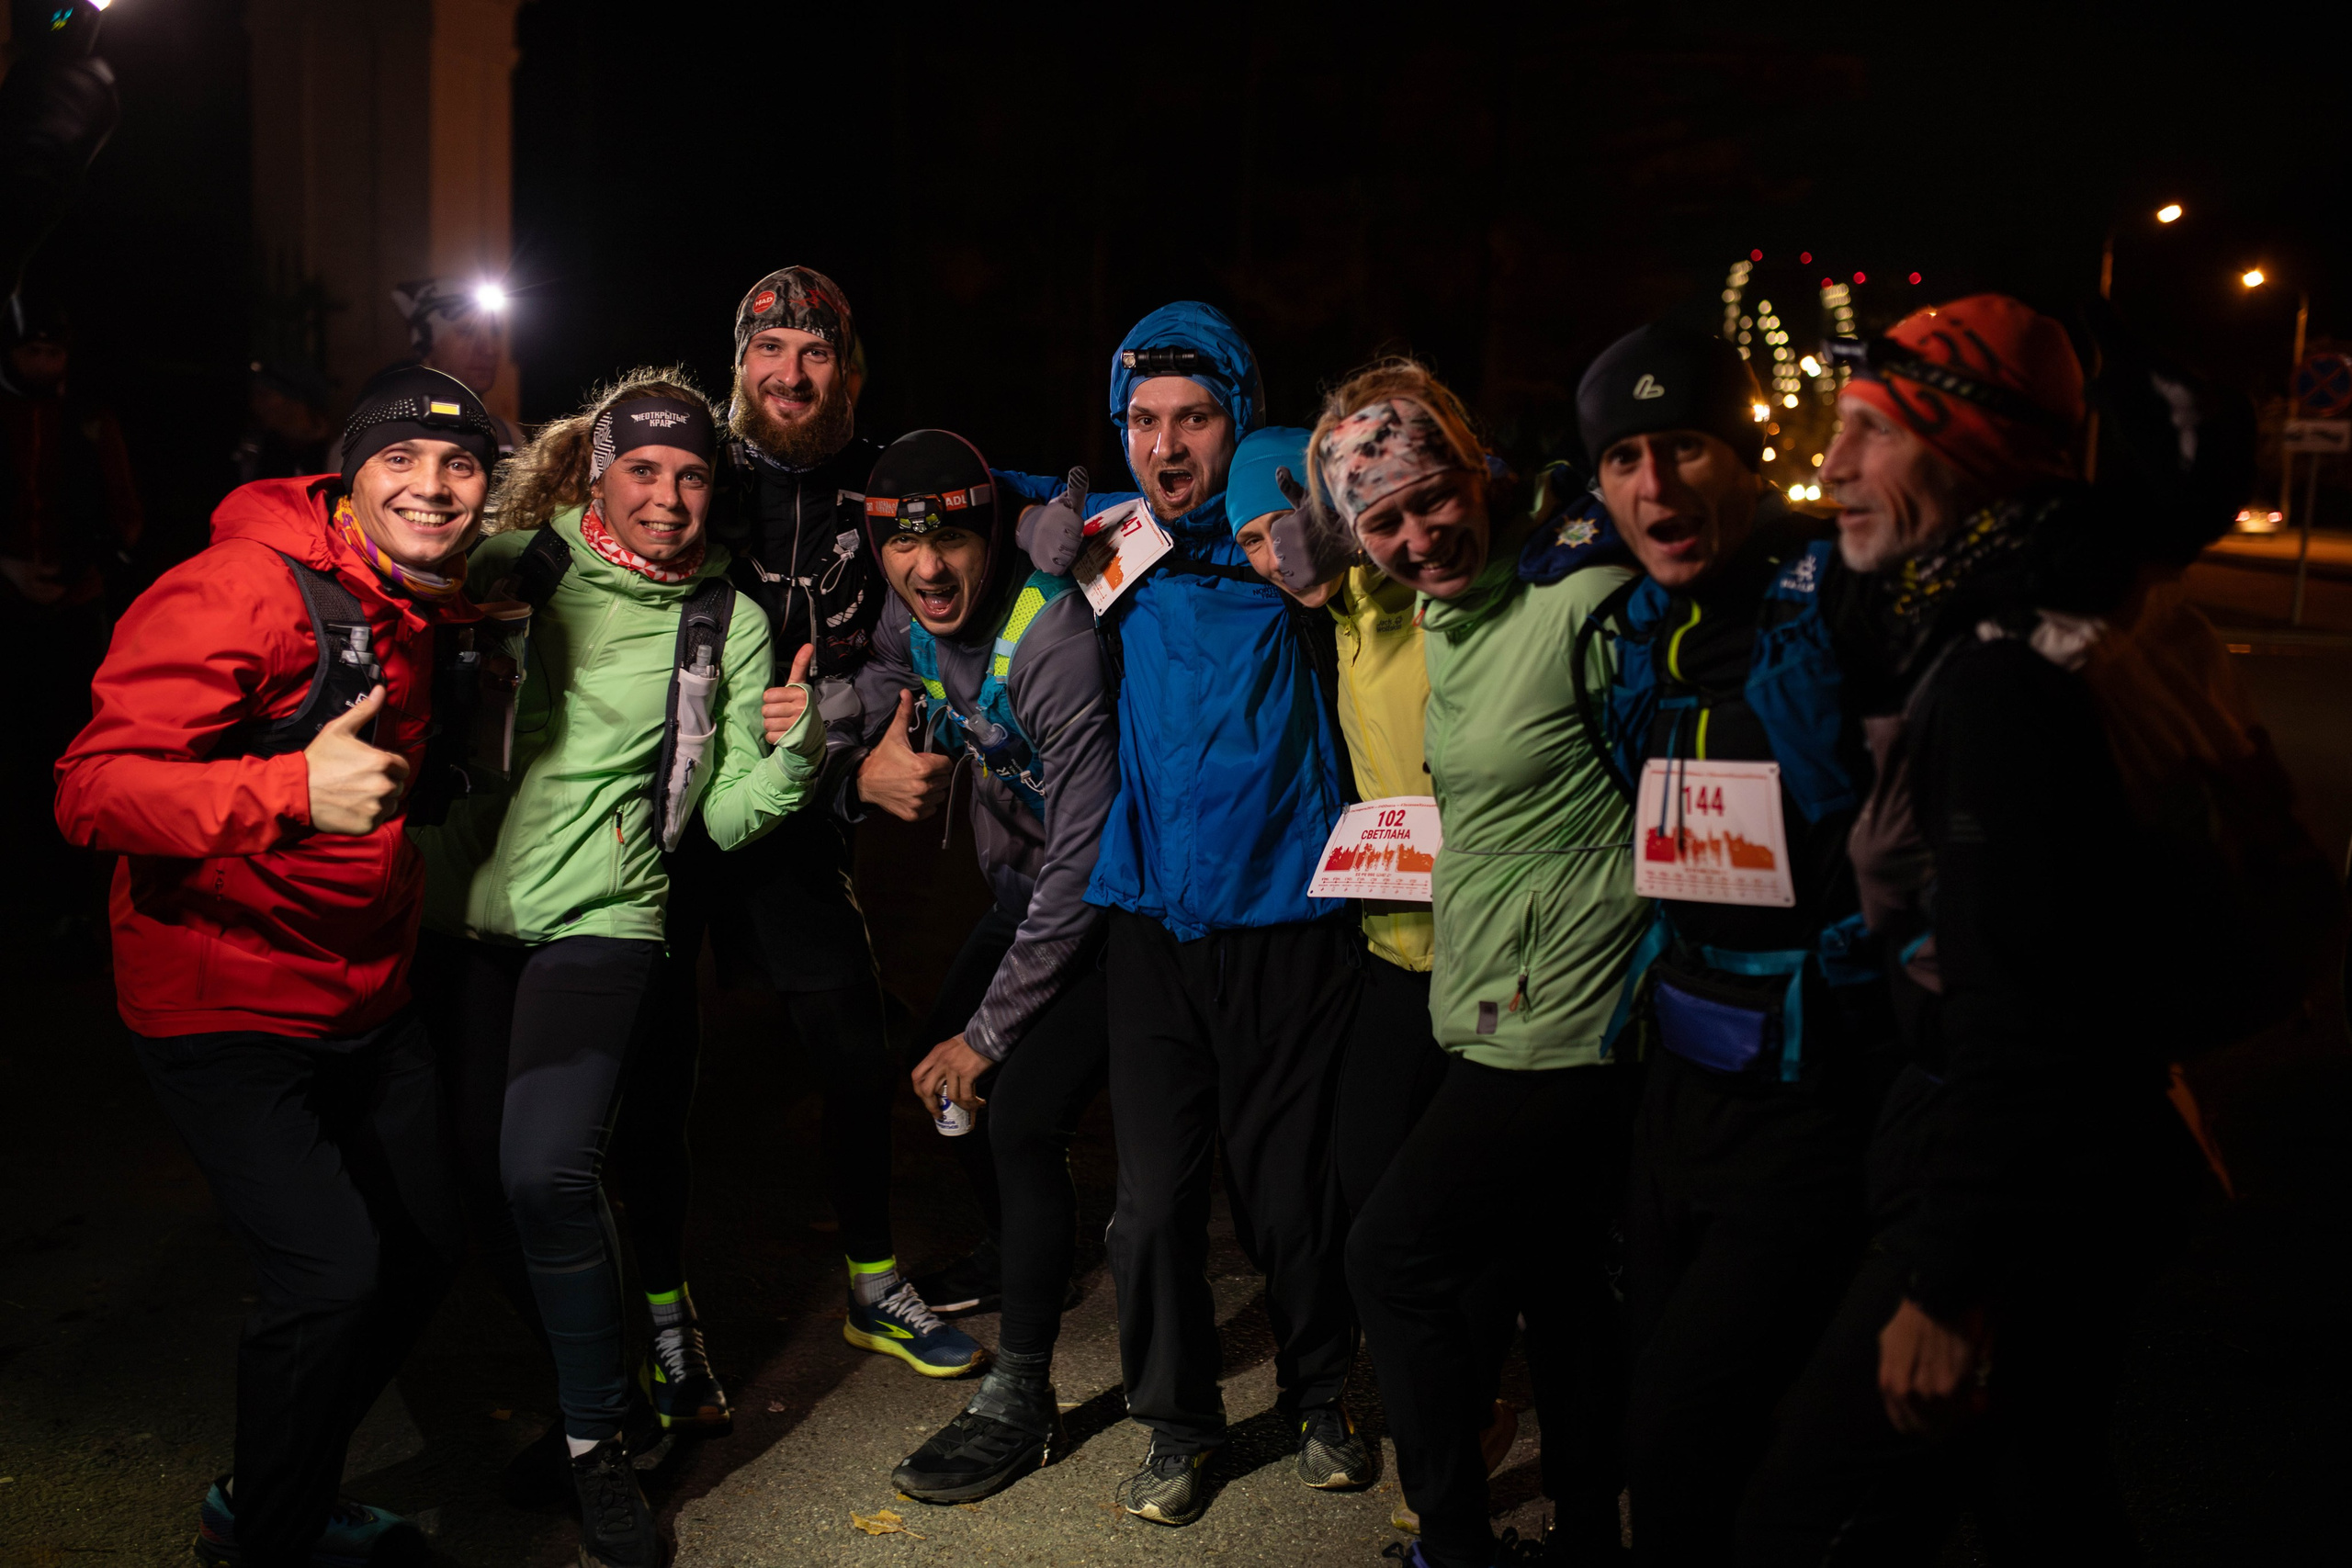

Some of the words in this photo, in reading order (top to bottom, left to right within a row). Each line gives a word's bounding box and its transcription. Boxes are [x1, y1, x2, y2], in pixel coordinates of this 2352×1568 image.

[635, 412, 687, 424] НЕОТКРЫТЫЕ
[1682, 785, 1725, 817] 144
[1377, 809, 1407, 828] 102
[1361, 829, 1411, 840] СВЕТЛАНА
